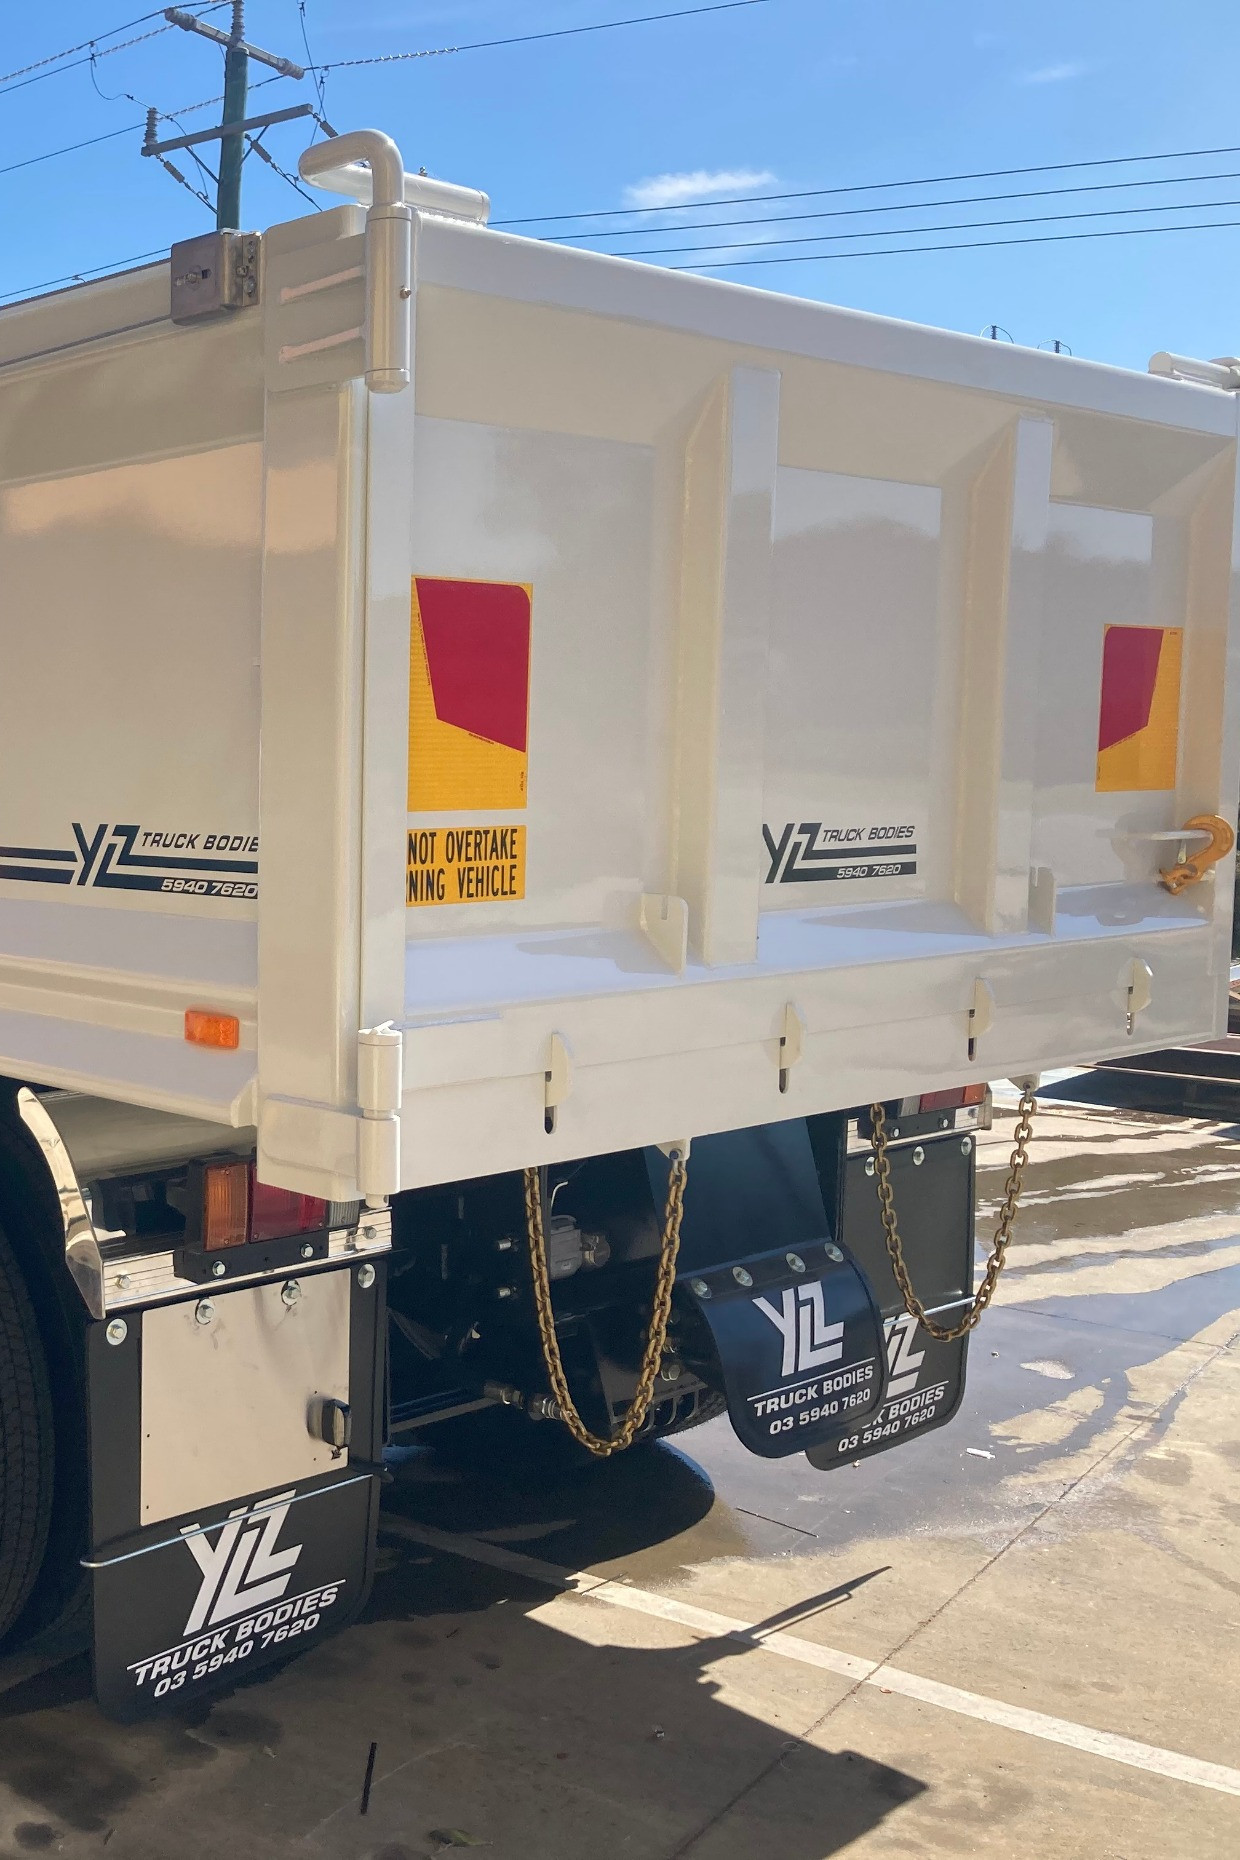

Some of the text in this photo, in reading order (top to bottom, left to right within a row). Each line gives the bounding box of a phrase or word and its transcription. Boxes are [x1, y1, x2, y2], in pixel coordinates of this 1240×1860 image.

[142, 832, 201, 850] TRUCK
[407, 828, 518, 866] NOT OVERTAKE
[822, 825, 915, 843] TRUCK BODIES
[161, 878, 258, 898] 5940 7620
[406, 864, 517, 903] NING VEHICLE
[836, 864, 902, 879] 5940 7620
[754, 1365, 874, 1417] TRUCK BODIES
[888, 1386, 945, 1421] BODIES
[769, 1419, 794, 1435] 03
[799, 1403, 839, 1425] 5940
[843, 1388, 871, 1410] 7620
[838, 1435, 859, 1452] 03
[862, 1420, 900, 1444] 5940
[904, 1405, 935, 1429] 7620
[135, 1586, 339, 1686] TRUCK BODIES
[154, 1613, 320, 1698] 03 5940 7620
